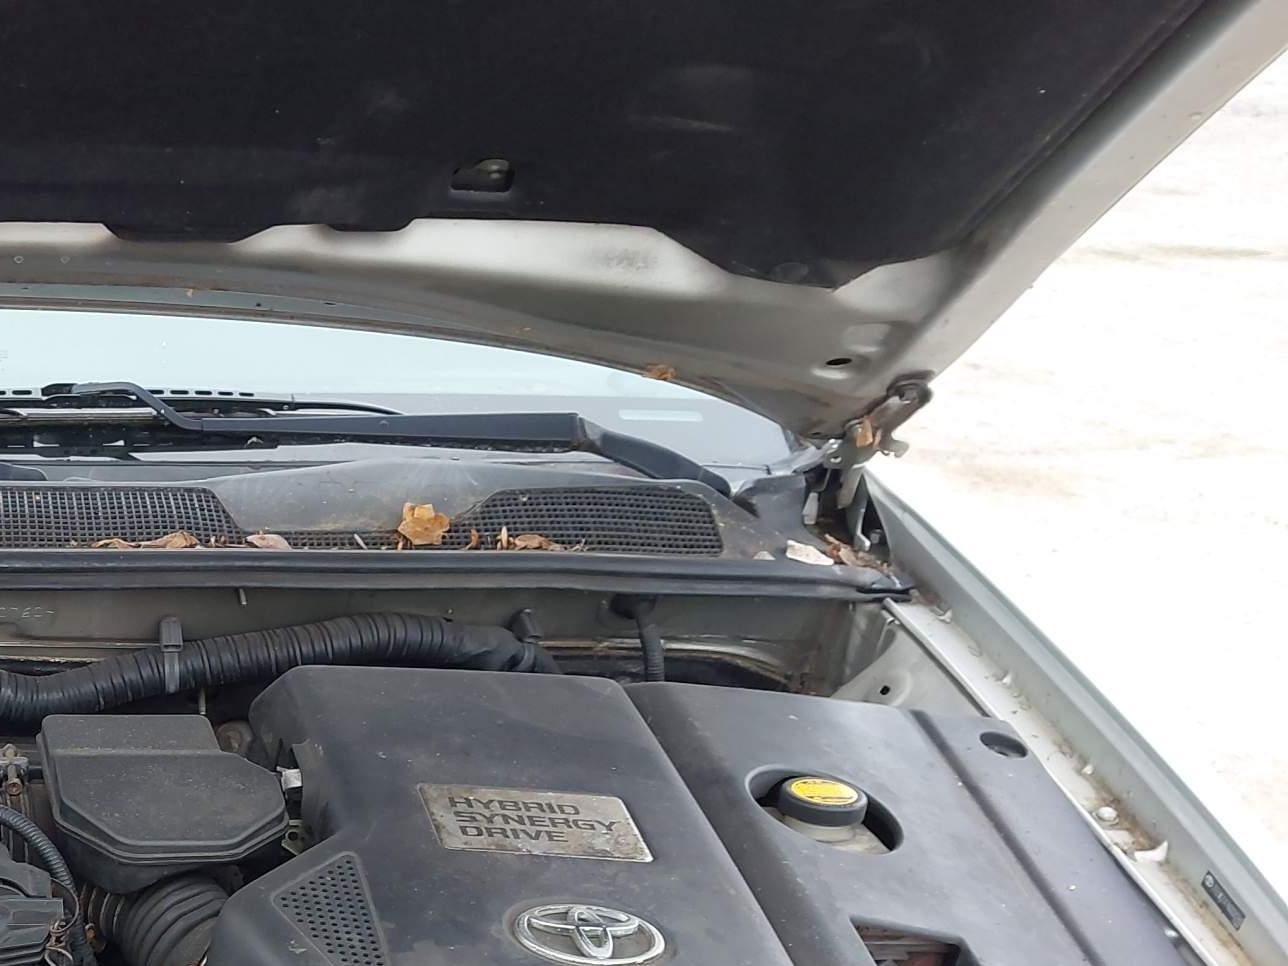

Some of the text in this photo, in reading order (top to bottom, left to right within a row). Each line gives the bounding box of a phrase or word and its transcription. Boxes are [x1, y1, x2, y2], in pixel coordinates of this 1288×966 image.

[449, 797, 580, 815] HYBRID
[454, 812, 617, 831] SYNERGY
[460, 826, 568, 842] DRIVE
